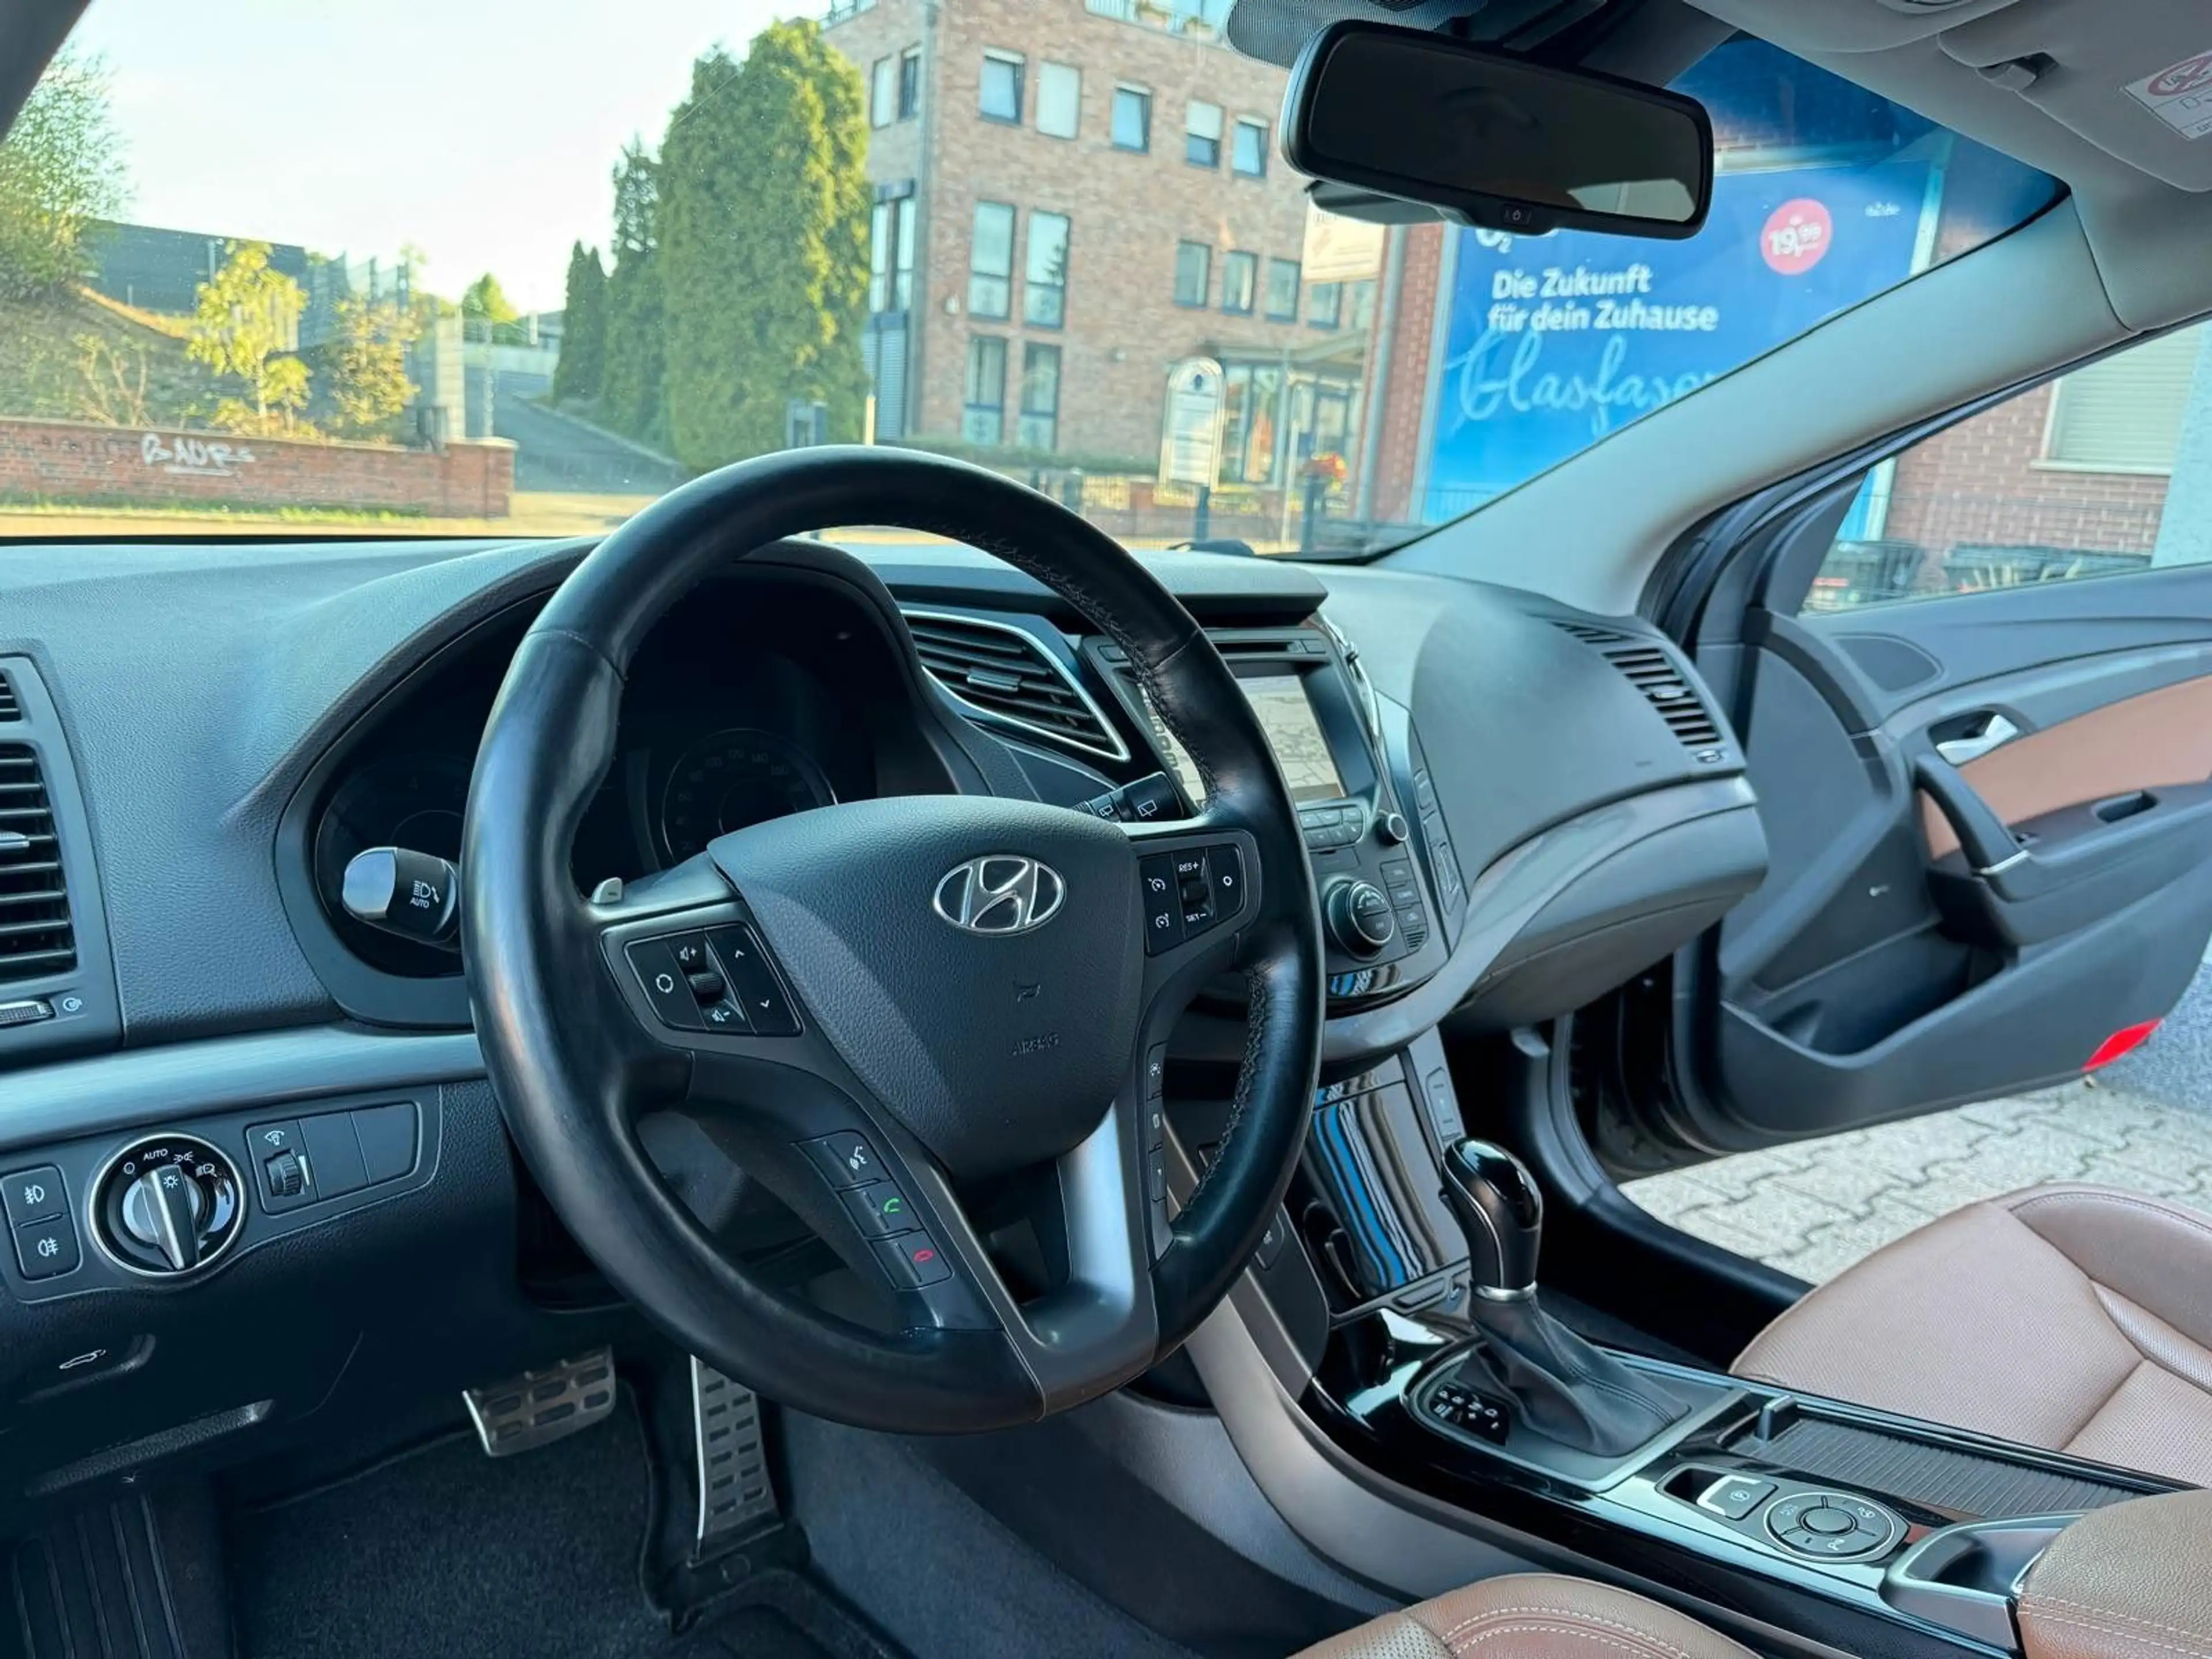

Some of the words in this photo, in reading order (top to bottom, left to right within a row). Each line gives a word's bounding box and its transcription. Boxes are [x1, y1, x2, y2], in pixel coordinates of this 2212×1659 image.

[1492, 268, 1537, 299] Die
[1540, 263, 1654, 298] Zukunft
[1488, 302, 1529, 332] für
[1531, 300, 1590, 332] dein
[1593, 298, 1719, 332] Zuhause
[410, 897, 430, 909] AUTO
[143, 1148, 168, 1161] AUTO
